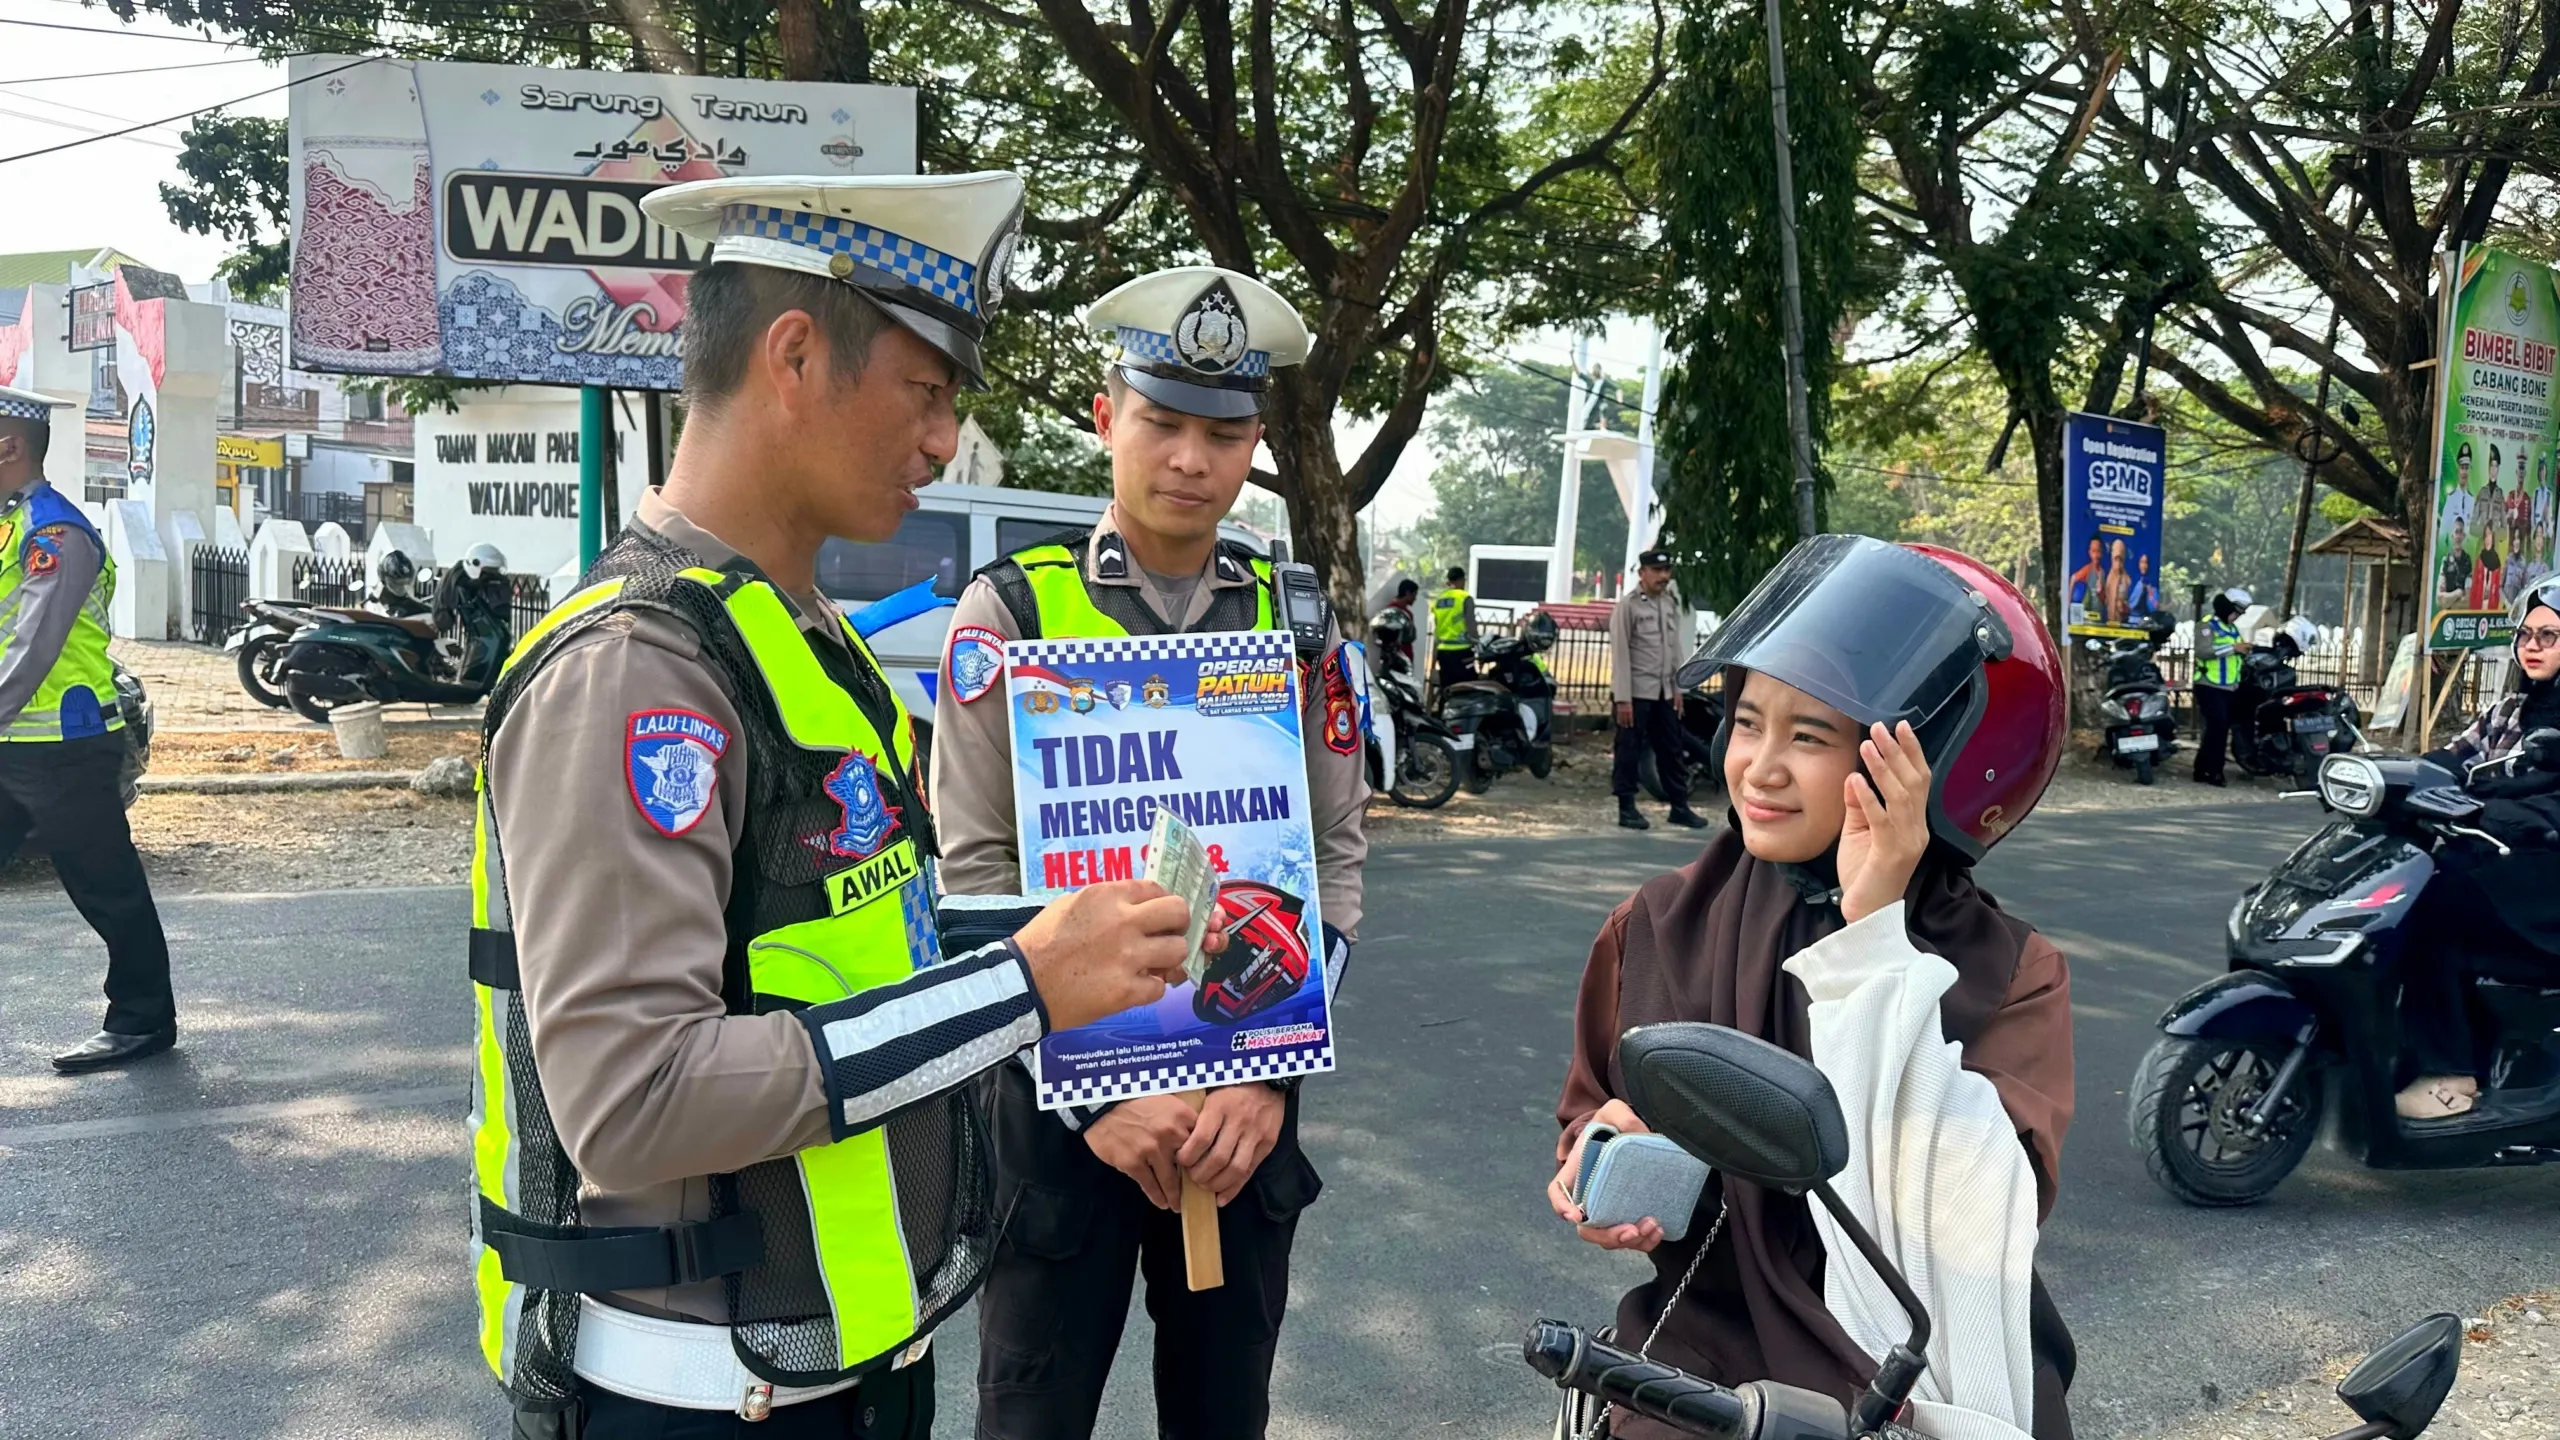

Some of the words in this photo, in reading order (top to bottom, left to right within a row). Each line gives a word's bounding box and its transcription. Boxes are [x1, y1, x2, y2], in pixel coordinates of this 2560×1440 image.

[521, 84, 664, 121] Sarung
[692, 93, 808, 124] Tenun
[2464, 329, 2520, 366] BIMBEL
[2523, 342, 2556, 374] BIBIT
[2473, 368, 2519, 393] CABANG
[2521, 377, 2547, 398] BONE
[2459, 394, 2496, 409] MENERIMA
[2497, 399, 2522, 413] PESERTA
[2466, 409, 2500, 424] PROGRAM
[2501, 414, 2520, 427] TAHUN
[434, 434, 477, 464] TAMAN
[486, 432, 536, 464] MAKAM
[546, 430, 625, 464] PAHLN
[2083, 436, 2106, 455] Open
[2106, 441, 2158, 465] Registration
[2091, 463, 2149, 496] SPMB
[468, 481, 580, 519] WATAMPONE
[956, 628, 978, 638] LALU
[1197, 658, 1285, 677] OPERASI
[1196, 672, 1287, 698] PATUH
[1197, 692, 1259, 709] PALLAWA
[1221, 706, 1242, 714] LANTAS
[635, 715, 677, 736] LALU
[681, 716, 725, 751] LINTAS
[1033, 730, 1182, 789] TIDAK
[842, 850, 911, 908] AWAL
[1043, 846, 1133, 889] HELM
[1247, 1029, 1325, 1049] MASYARAKAT
[1275, 1023, 1314, 1034] BERSAMA
[1116, 1046, 1132, 1056] lalu
[1133, 1044, 1155, 1053] lintas
[1156, 1040, 1177, 1052] yang
[1178, 1037, 1204, 1048] tertib,
[1075, 1062, 1099, 1071] aman
[1100, 1058, 1117, 1067] dan
